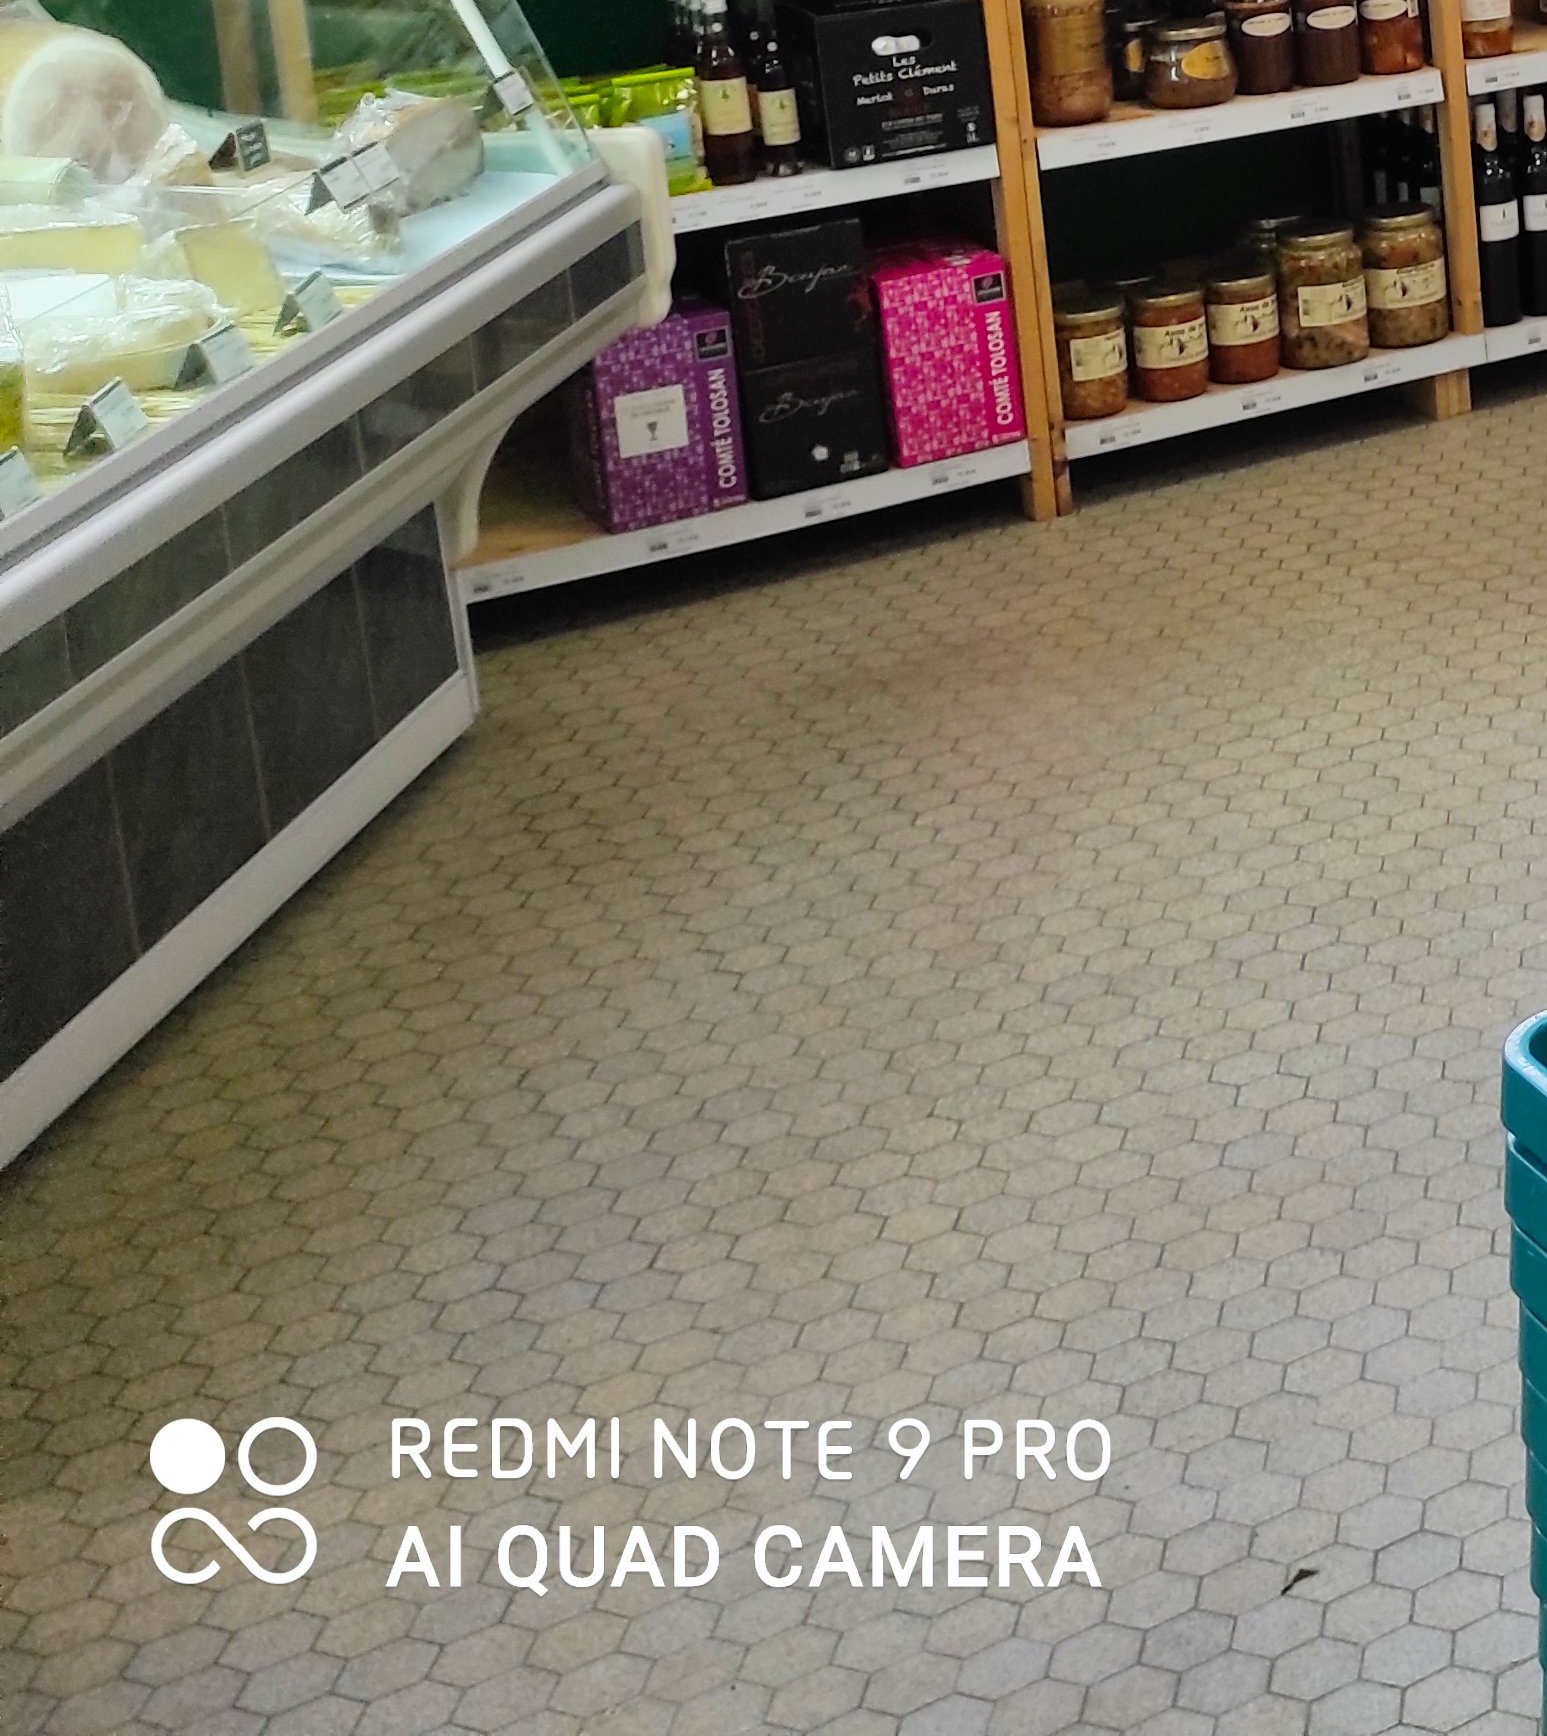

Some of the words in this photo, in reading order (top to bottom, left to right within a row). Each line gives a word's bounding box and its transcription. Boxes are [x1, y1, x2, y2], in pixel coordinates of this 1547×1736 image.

[852, 70, 893, 87] Petits
[898, 60, 959, 79] Clément
[893, 55, 916, 67] Les
[985, 311, 1007, 376] TOLOSAN
[707, 367, 734, 432] TOLOSAN
[988, 376, 1014, 425] COMTÉ
[710, 434, 737, 489] COMTÉ
